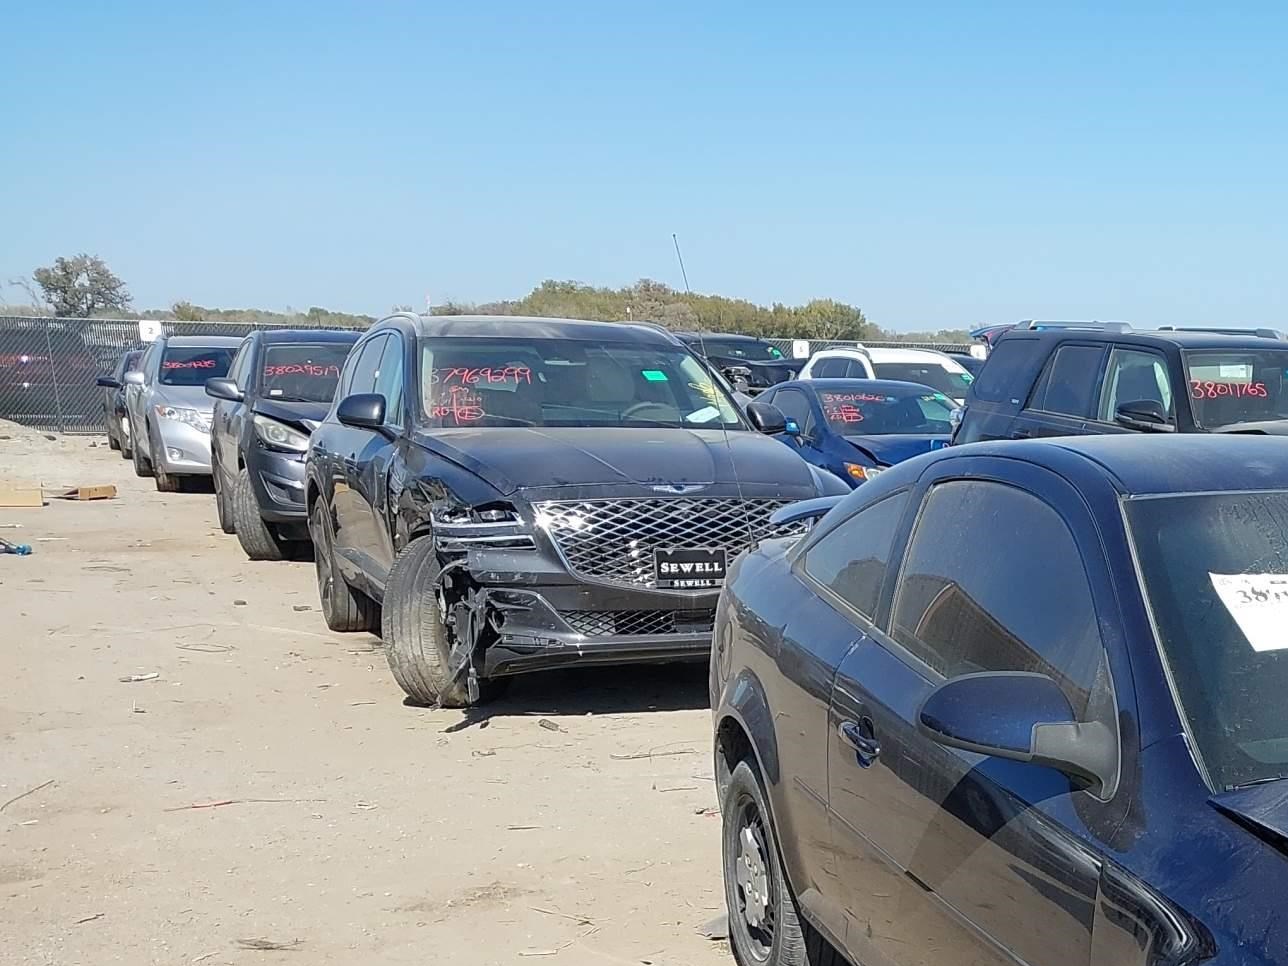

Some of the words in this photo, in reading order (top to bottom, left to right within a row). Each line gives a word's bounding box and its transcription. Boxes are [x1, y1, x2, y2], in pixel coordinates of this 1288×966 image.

[264, 364, 340, 378] 38029519
[431, 367, 531, 384] 37969299
[1190, 378, 1267, 399] 38011765
[660, 561, 723, 573] SEWELL
[673, 579, 712, 587] SEWELL
